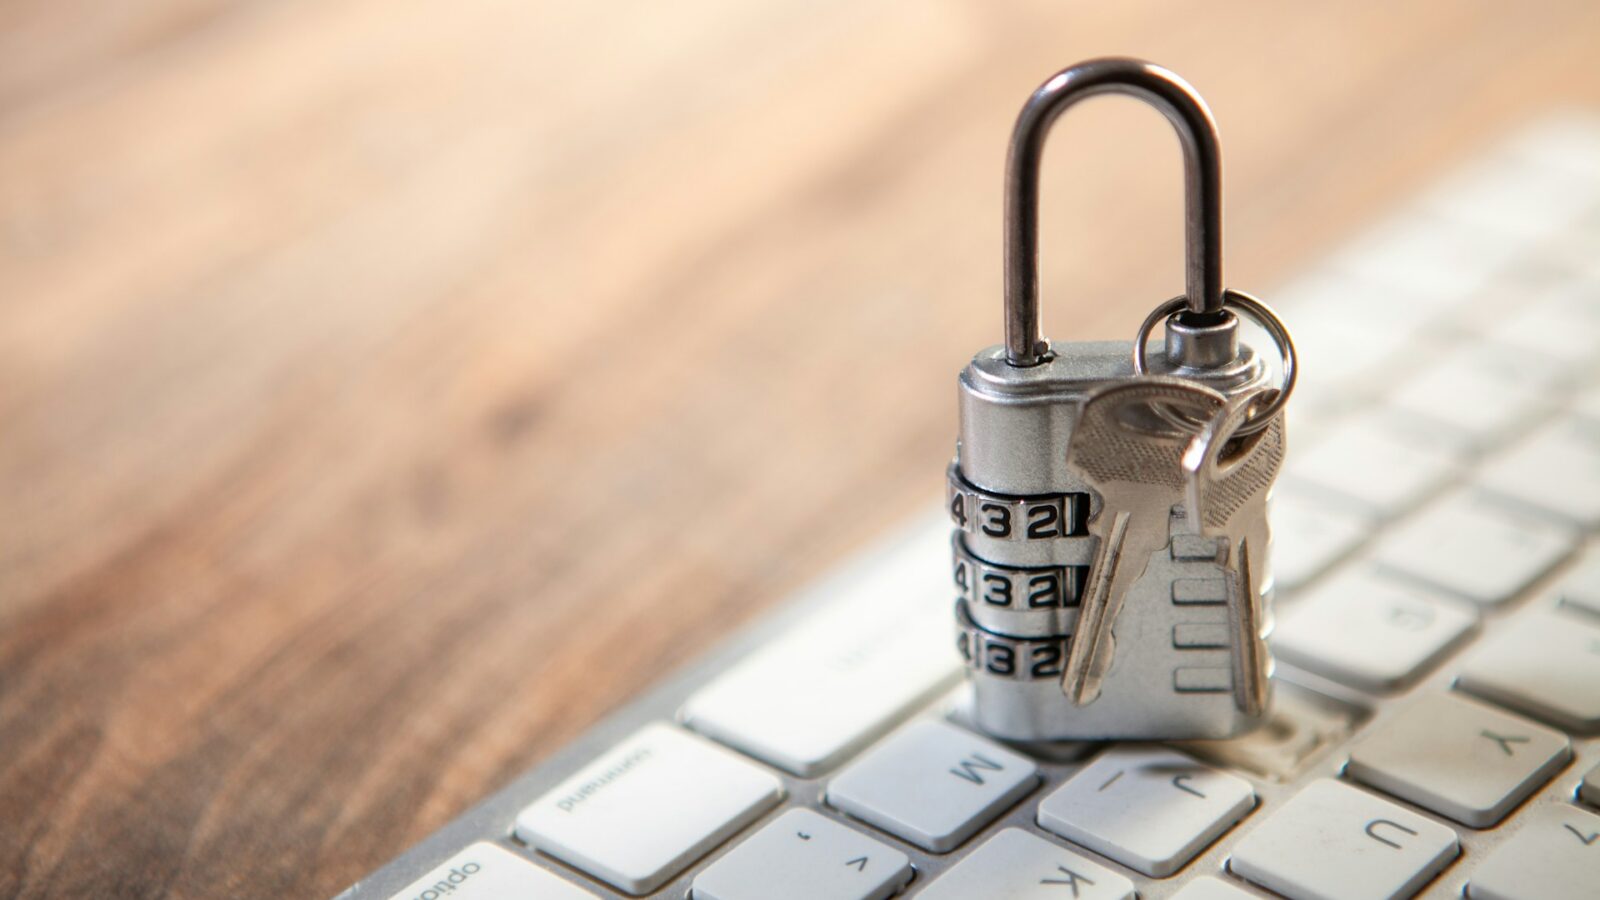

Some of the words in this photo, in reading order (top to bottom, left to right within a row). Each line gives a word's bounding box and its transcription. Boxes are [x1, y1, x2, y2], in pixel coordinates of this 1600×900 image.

[1480, 728, 1531, 757] Y
[949, 752, 1005, 786] M
[1171, 774, 1207, 800] J
[1364, 819, 1419, 850] U
[412, 862, 480, 900] optio
[1039, 865, 1096, 899] K
